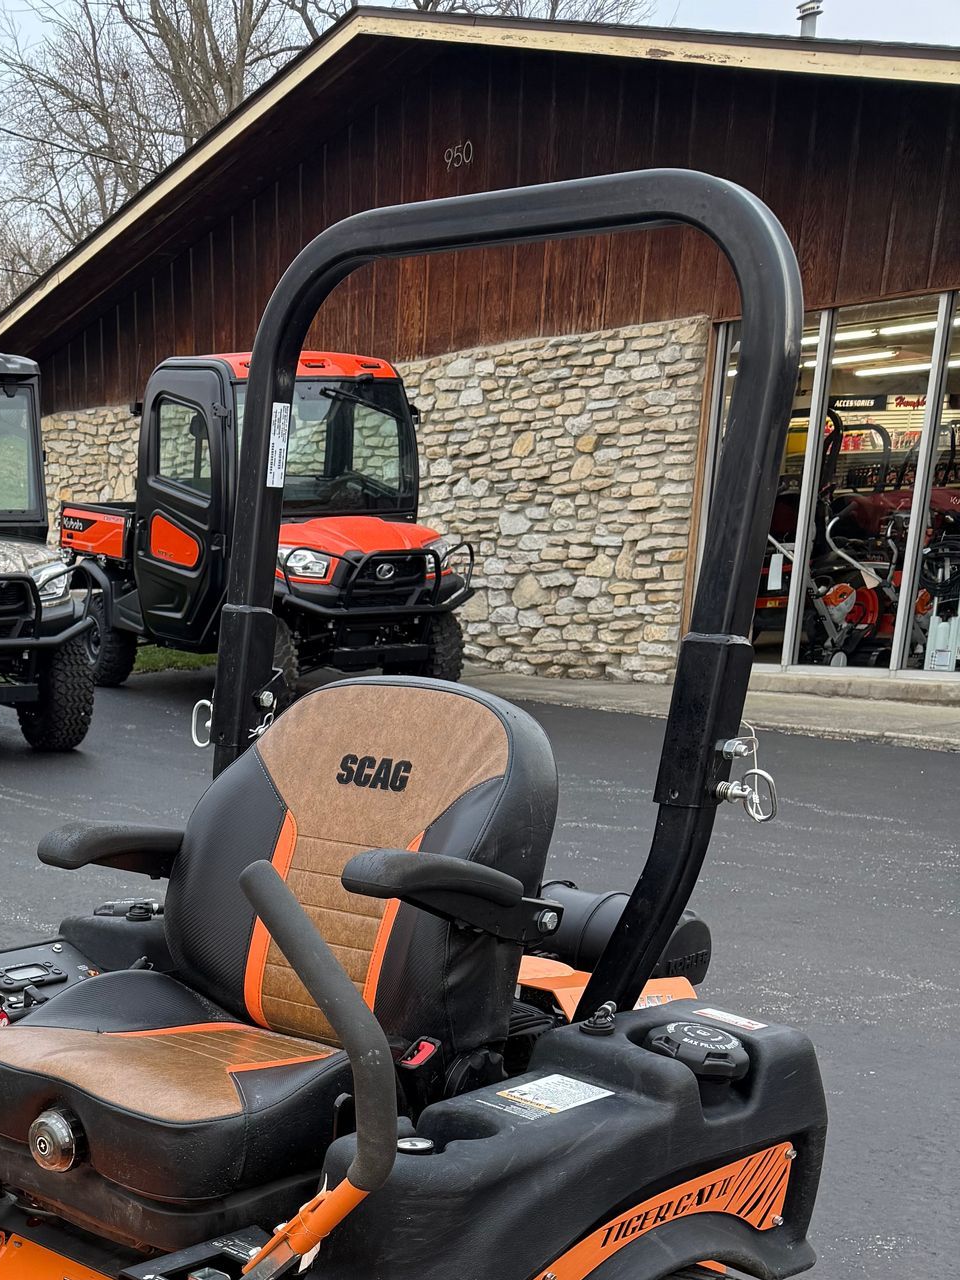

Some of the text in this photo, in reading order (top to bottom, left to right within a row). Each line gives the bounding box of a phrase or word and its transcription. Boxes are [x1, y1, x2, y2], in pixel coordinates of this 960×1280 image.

[444, 140, 473, 172] 950
[834, 399, 875, 408] ACCESSORIES
[336, 753, 413, 792] SCAG
[601, 1201, 674, 1247] TIGER
[674, 1185, 718, 1214] CAT
